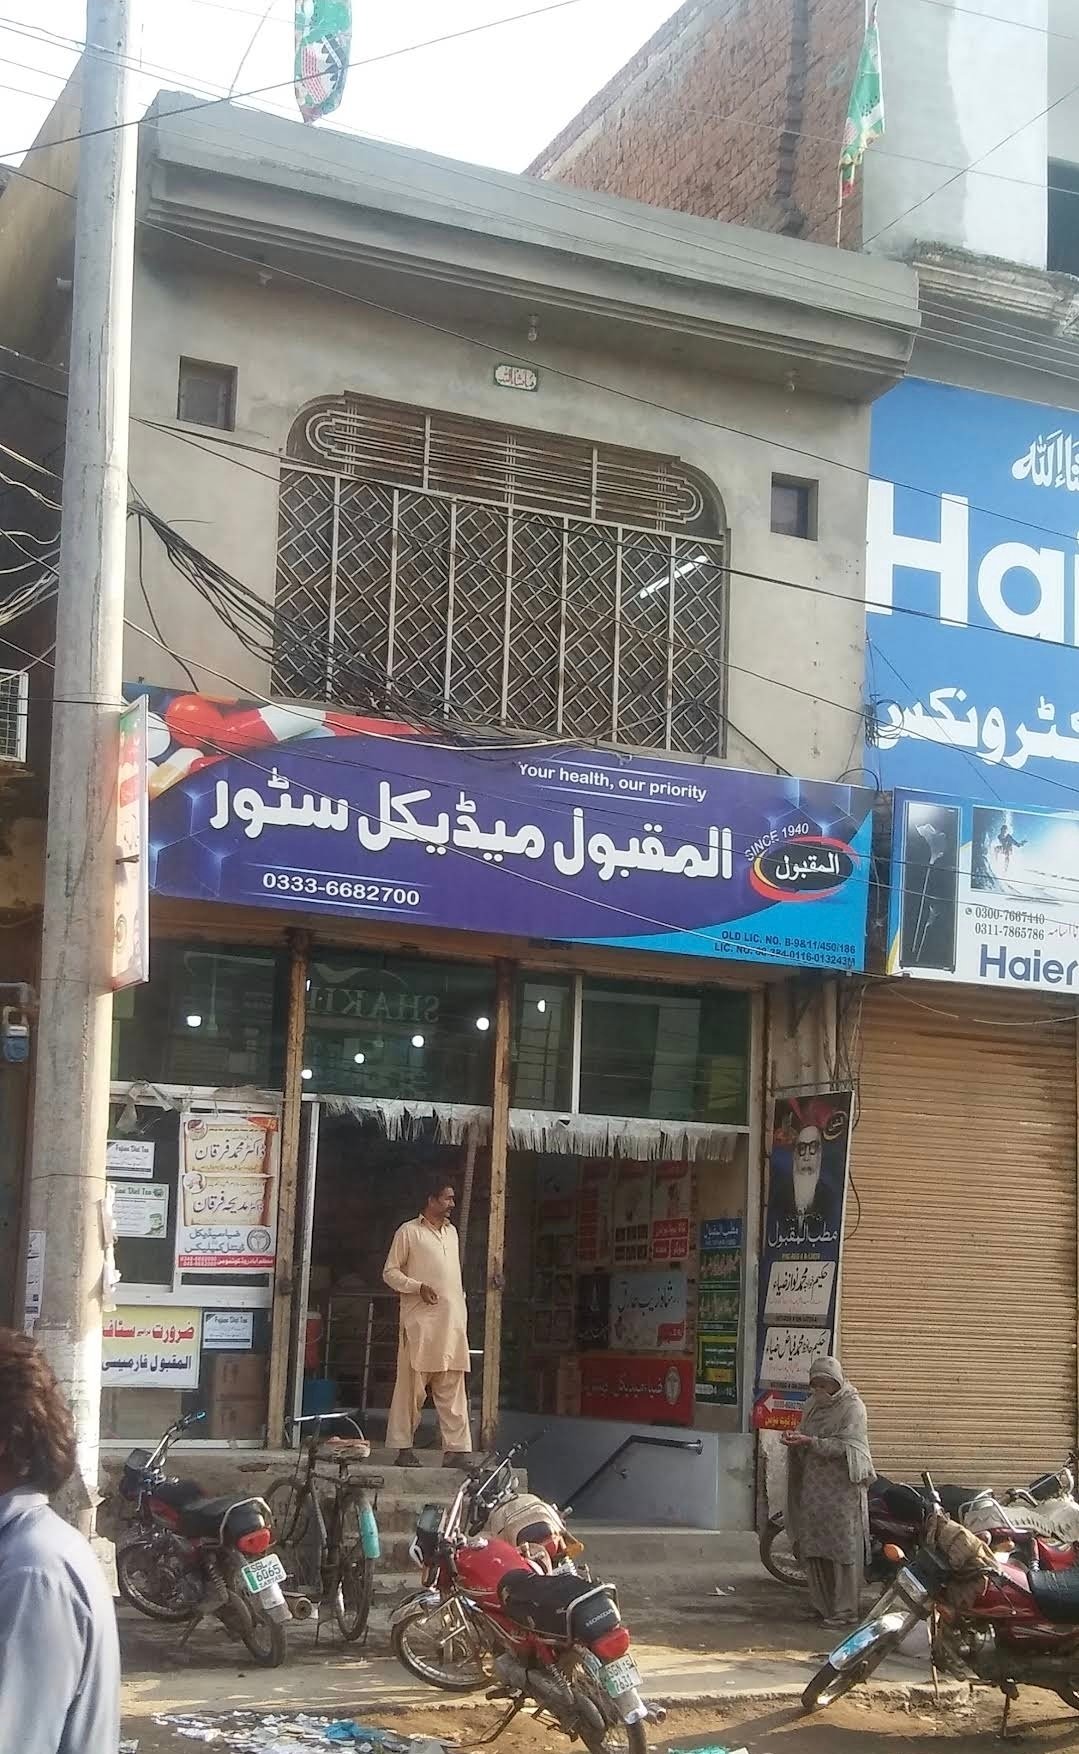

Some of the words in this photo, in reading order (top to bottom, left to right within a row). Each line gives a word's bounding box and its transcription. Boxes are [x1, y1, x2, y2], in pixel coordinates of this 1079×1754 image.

[865, 478, 1079, 648] Ha
[519, 762, 556, 779] Your
[559, 767, 615, 790] health,
[618, 778, 646, 792] our
[649, 781, 707, 802] priority
[209, 767, 349, 839] سٹور
[358, 781, 546, 862] میڈیکل
[553, 807, 733, 881] المقبول
[744, 829, 780, 861] SINCE
[782, 823, 809, 838] 1940
[775, 851, 840, 881] المقبول
[262, 872, 421, 906] 0333-6682700
[714, 942, 733, 952] LIC.
[721, 930, 741, 940] OLD
[744, 933, 762, 944] LIC.
[765, 935, 782, 946] NO.
[975, 922, 1045, 941] 0311-7865786
[979, 943, 1079, 987] Haier
[101, 1353, 149, 1372] فارمیسی
[150, 1354, 192, 1373] المقبول
[256, 1563, 281, 1582] 6065
[585, 1608, 615, 1628] HONDA
